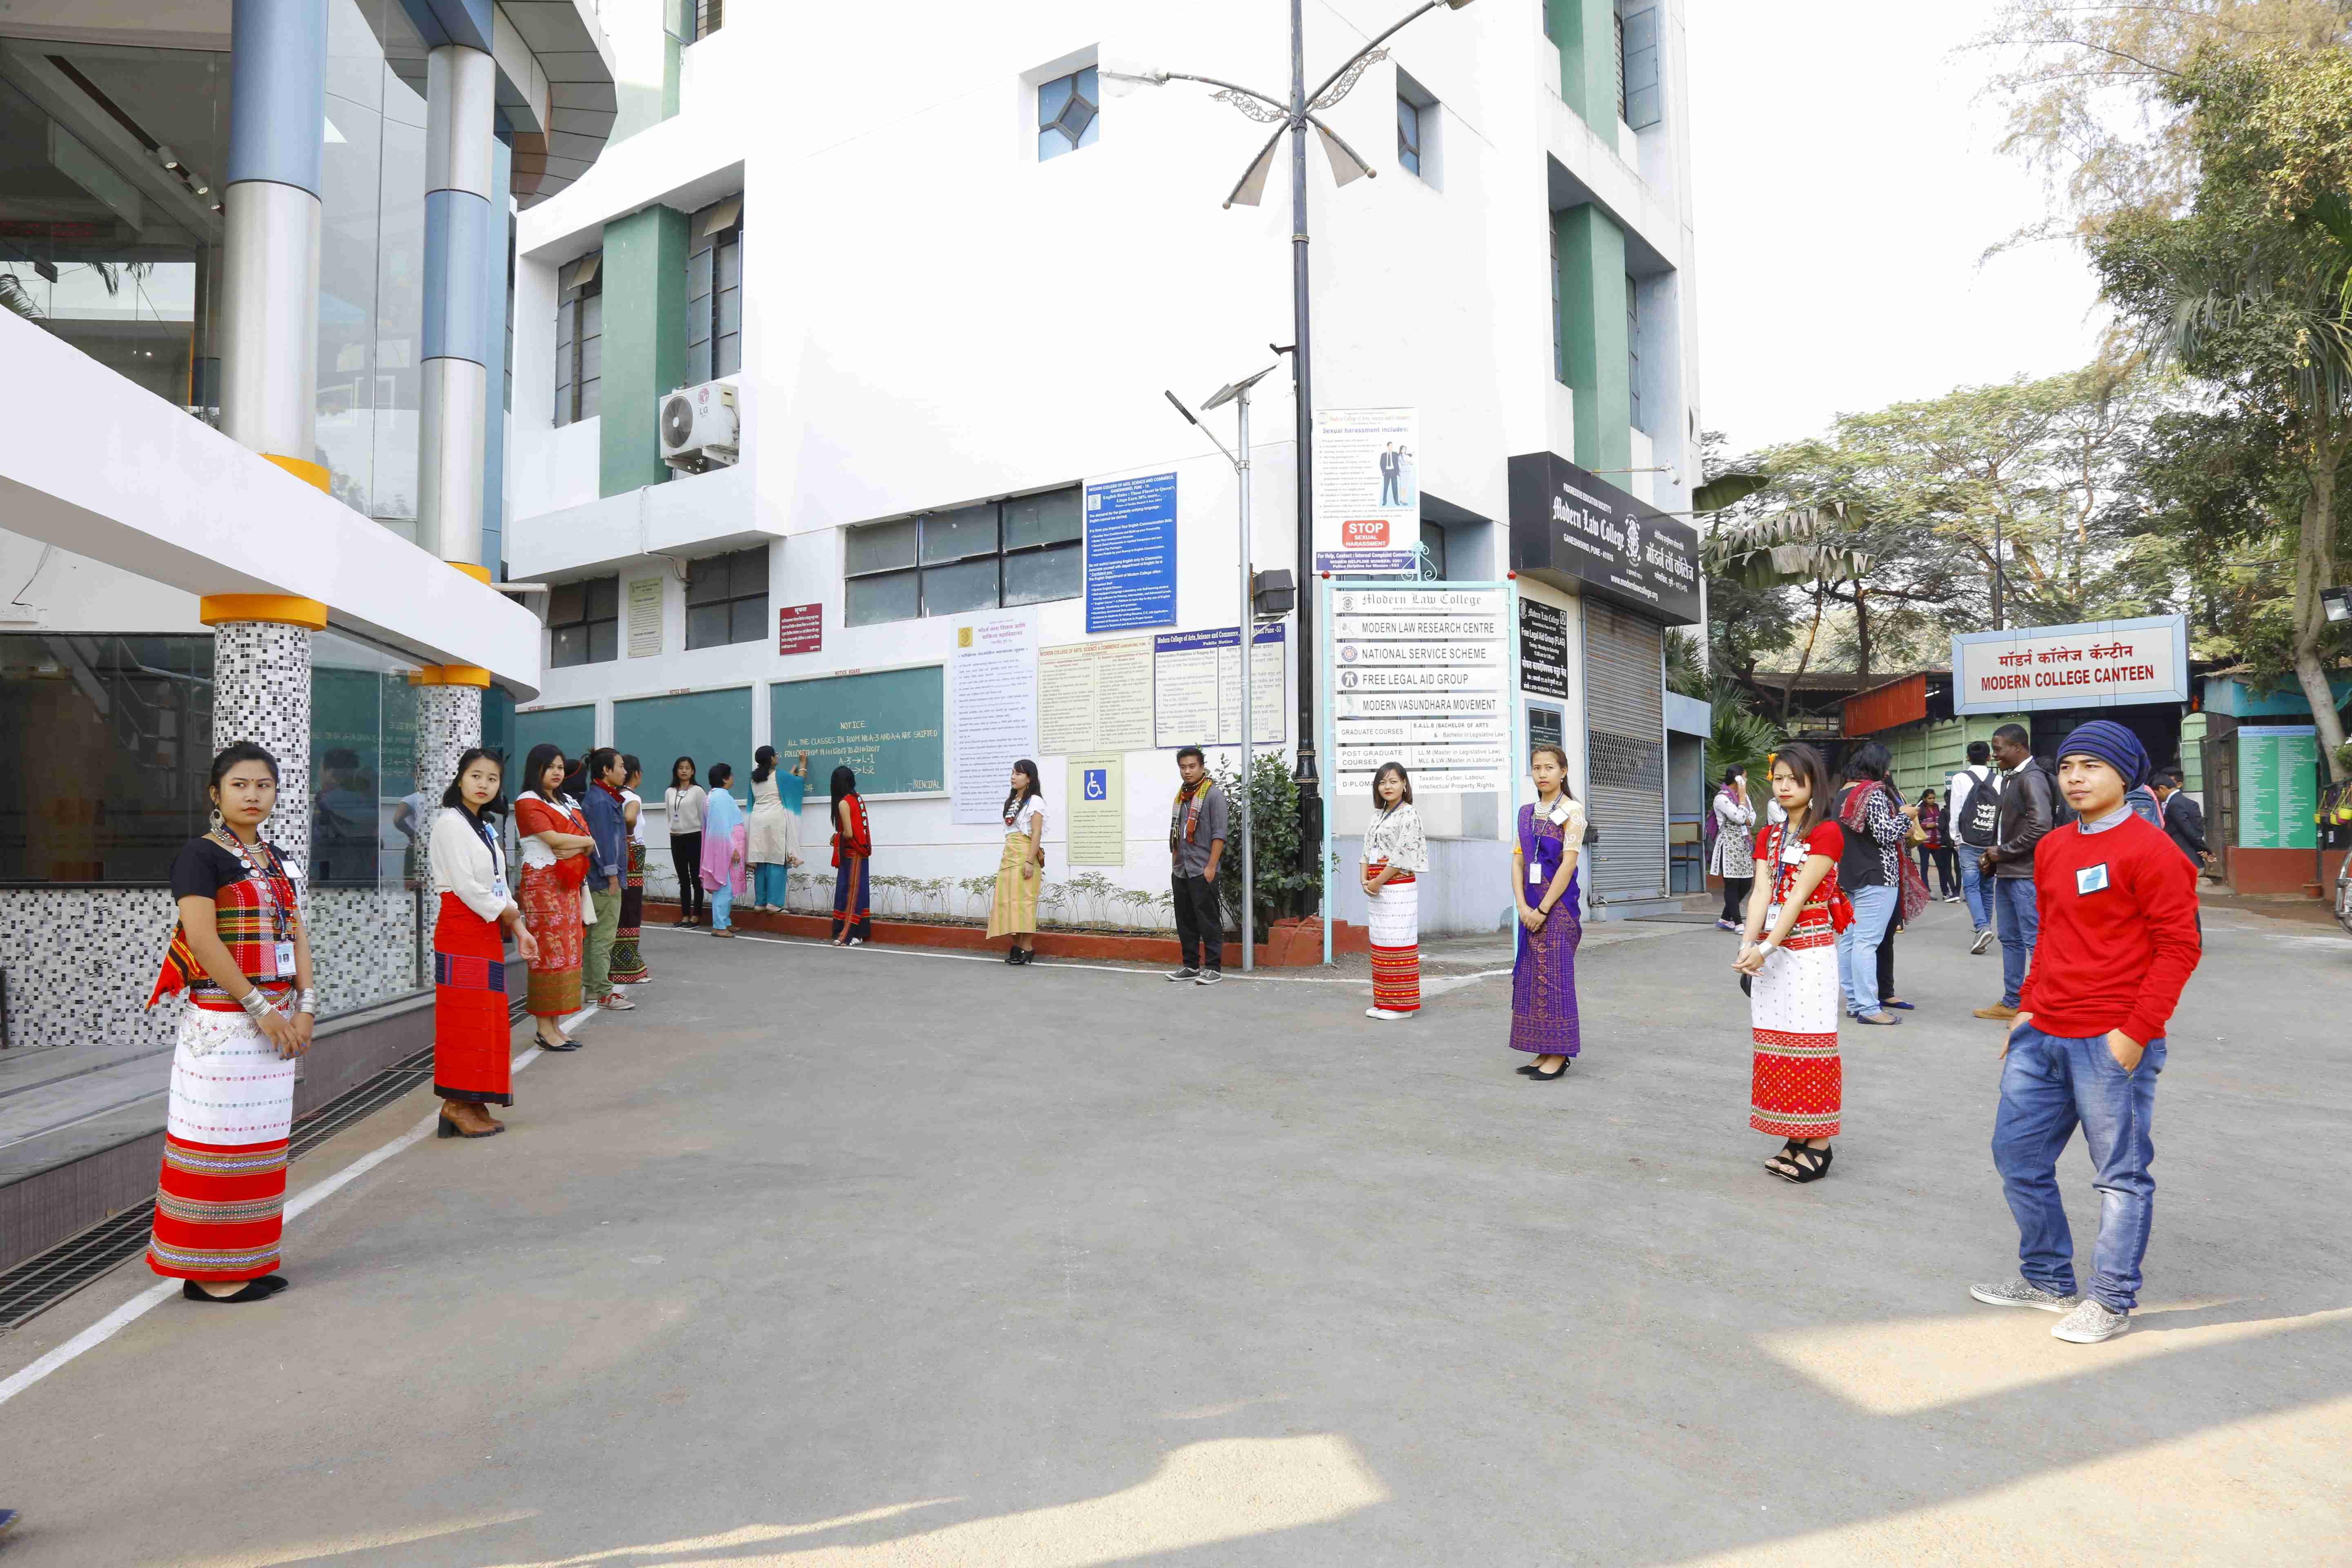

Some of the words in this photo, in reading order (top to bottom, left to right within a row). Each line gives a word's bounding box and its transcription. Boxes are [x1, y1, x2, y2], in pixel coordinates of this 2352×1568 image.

[699, 406, 708, 414] LG
[1564, 482, 1582, 500] PROGRESSIVE
[1583, 492, 1598, 508] EDUCATION
[1349, 523, 1383, 534] STOP
[1553, 496, 1581, 529] Modern
[1582, 508, 1599, 537] Law
[1600, 518, 1624, 551] College
[1591, 546, 1600, 556] PUNE
[1646, 542, 1664, 568] मॉडर्न
[1665, 551, 1674, 572] लॉ
[1674, 556, 1694, 581] कॉलेज
[1610, 575, 1658, 601] www.modernlawcollege.org
[1362, 593, 1406, 605] Modern
[1411, 593, 1436, 604] Law
[1440, 593, 1481, 606] College
[1528, 608, 1541, 619] Modern
[1548, 615, 1559, 626] College
[1362, 623, 1397, 633] MODERN
[1399, 622, 1415, 633] LAW
[1418, 622, 1461, 633] RESEARCH
[1463, 622, 1494, 633] CENTRE
[1170, 635, 1183, 644] College
[1530, 629, 1539, 641] Legal
[1545, 633, 1554, 645] Group
[1555, 636, 1565, 648] (FLAG)
[1362, 649, 1407, 659] NATIONAL
[1409, 648, 1447, 659] SERVICE
[1450, 648, 1486, 659] SCHEME
[1998, 649, 2033, 667] मॉडर्न
[2037, 646, 2082, 664] कॉलेज
[2089, 642, 2134, 660] कॅन्टीन
[1363, 675, 1386, 685] FREE
[1389, 674, 1418, 684] LEGAL
[1420, 674, 1434, 684] AID
[1437, 674, 1468, 684] GROUP
[1981, 674, 2031, 691] MODERN
[2036, 669, 2091, 687] COLLEGE
[2094, 664, 2154, 683] CANTEEN
[1363, 700, 1396, 711] MODERN
[1399, 699, 1451, 710] VASUNDHARA
[1453, 699, 1496, 710] MOVEMENT
[840, 720, 866, 730] NOTICE
[787, 738, 797, 747] ALL
[811, 737, 836, 745] CLASSES
[846, 735, 860, 743] ROOM
[914, 730, 938, 738] SHIFTED
[839, 757, 851, 765] A-3
[862, 754, 875, 763] L-1
[862, 766, 875, 774] L-2
